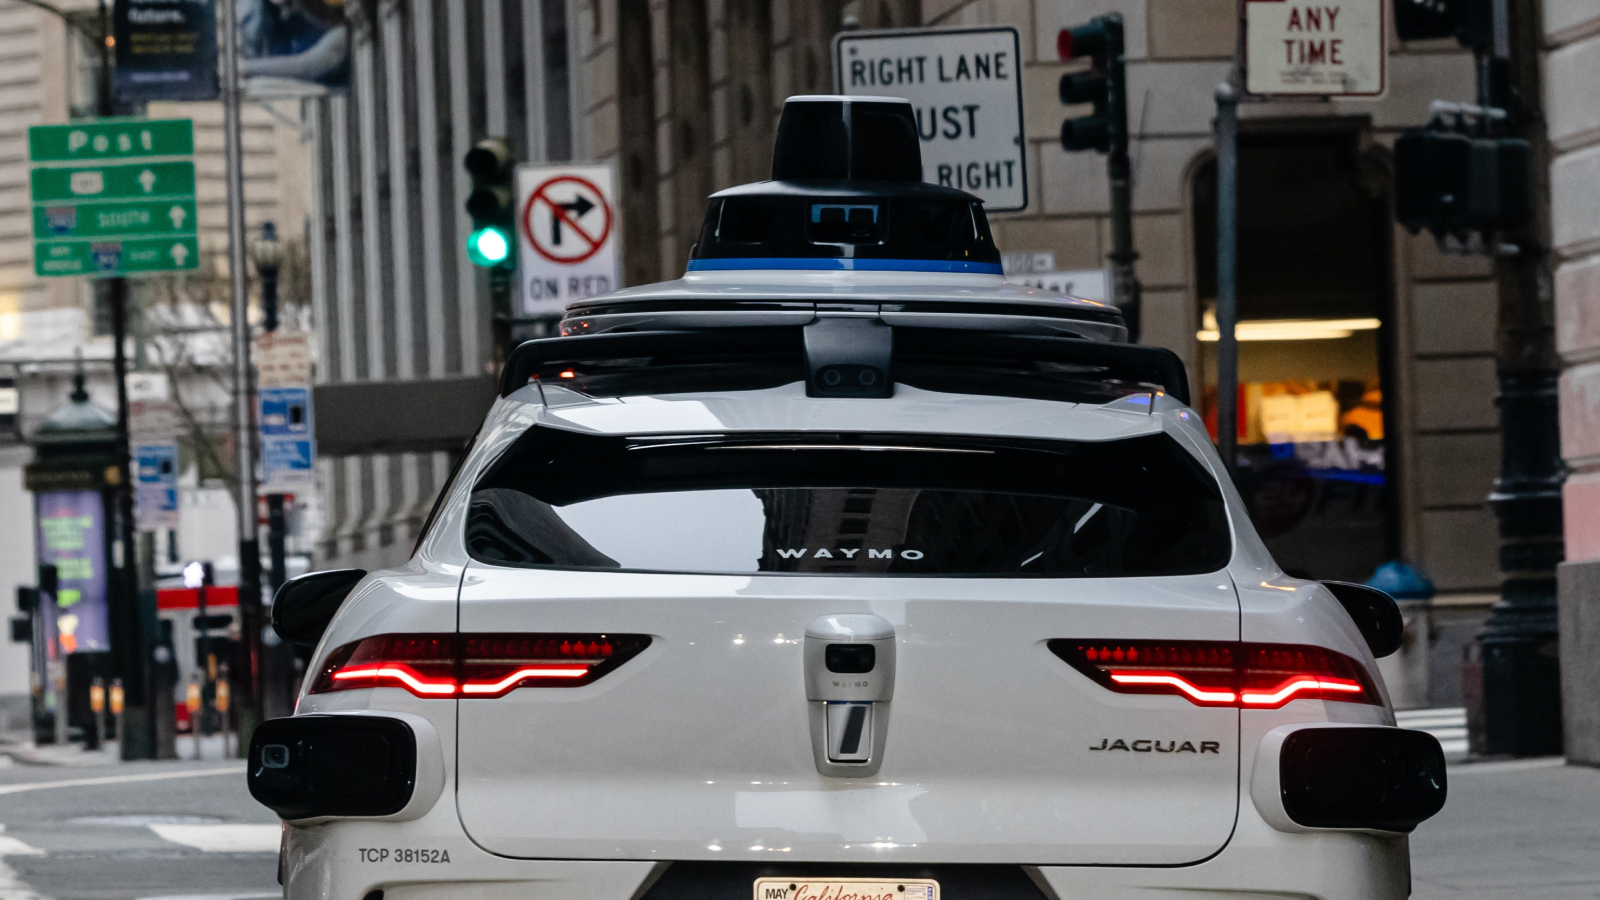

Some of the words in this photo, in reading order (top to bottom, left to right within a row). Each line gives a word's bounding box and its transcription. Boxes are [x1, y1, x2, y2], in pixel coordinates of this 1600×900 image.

[1287, 6, 1340, 32] ANY
[1283, 39, 1344, 65] TIME
[851, 56, 926, 86] RIGHT
[938, 52, 1009, 82] LANE
[916, 104, 980, 141] UST
[67, 129, 153, 154] Post
[937, 160, 1016, 190] RIGHT
[529, 275, 559, 301] ON
[567, 274, 610, 298] RED
[776, 548, 925, 560] WAYMO
[832, 680, 869, 688] WAYMO
[1089, 738, 1220, 754] JAGUAR
[358, 848, 389, 863] TCP
[394, 848, 451, 864] 38152A
[765, 888, 788, 900] MAY
